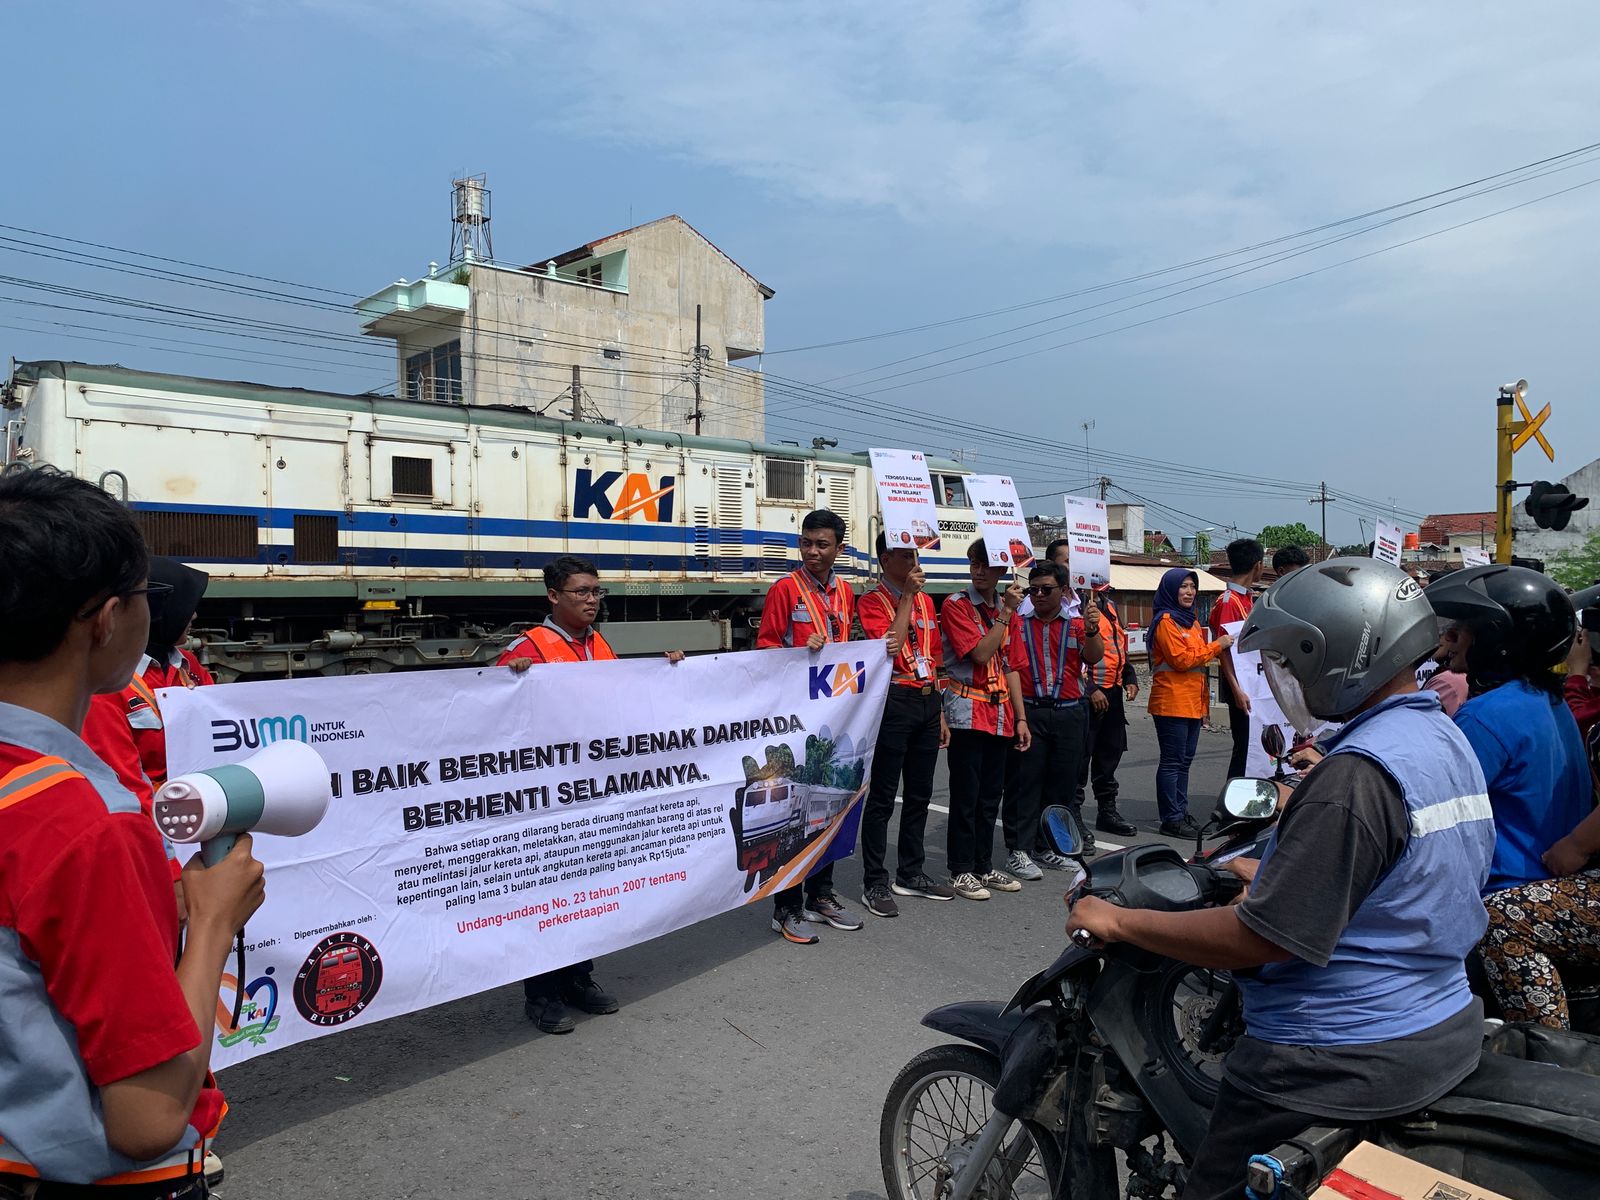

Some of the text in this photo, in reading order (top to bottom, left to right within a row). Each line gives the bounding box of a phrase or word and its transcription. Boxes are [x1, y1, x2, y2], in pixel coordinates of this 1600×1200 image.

[573, 468, 675, 522] KAI
[999, 501, 1015, 509] UBUR
[938, 521, 975, 532] CC 2030203
[809, 661, 865, 699] KAI
[310, 721, 346, 732] UNTUK
[311, 729, 365, 743] INDONESIA
[352, 761, 432, 796] BAIK
[439, 742, 581, 783] BERHENTI
[587, 728, 698, 761] SEJENAK
[703, 714, 806, 746] DARIPADA
[402, 763, 710, 833] BERHENTI SELAMANYA.
[394, 803, 724, 878] menyeret, menggerakkan, meletakkan, atau memindahkan barang di atas rel
[425, 797, 700, 857] Bahwa setiap orang dilarang berada diruang manfaat kereta api,
[396, 884, 458, 906] kepentingan
[460, 878, 481, 891] lain,
[483, 871, 512, 885] selain
[514, 866, 540, 879] untuk
[542, 858, 584, 873] angkutan
[586, 850, 612, 863] kereta
[630, 840, 667, 853] ancaman
[668, 833, 696, 847] pidana
[697, 828, 726, 841] penjara
[397, 815, 723, 891] atau melintasi jalur kereta api, ataupun menggunakan jalur kereta api untuk
[445, 894, 476, 910] paling
[478, 888, 501, 900] lama
[503, 884, 509, 894] 3
[511, 879, 537, 892] bulan
[538, 875, 558, 886] atau
[560, 867, 587, 881] denda
[589, 861, 616, 877] paling
[617, 854, 647, 868] banyak
[457, 870, 687, 934] Undang-undang No. 23 tahun 2007 tentang
[294, 919, 356, 940] Dipersembahkan
[357, 914, 373, 925] oleh
[538, 902, 620, 932] perkeretaapian
[258, 937, 276, 949] oleh
[298, 934, 379, 978] RAILFANS
[247, 1007, 268, 1021] KAI
[310, 1002, 365, 1024] BLITAR
